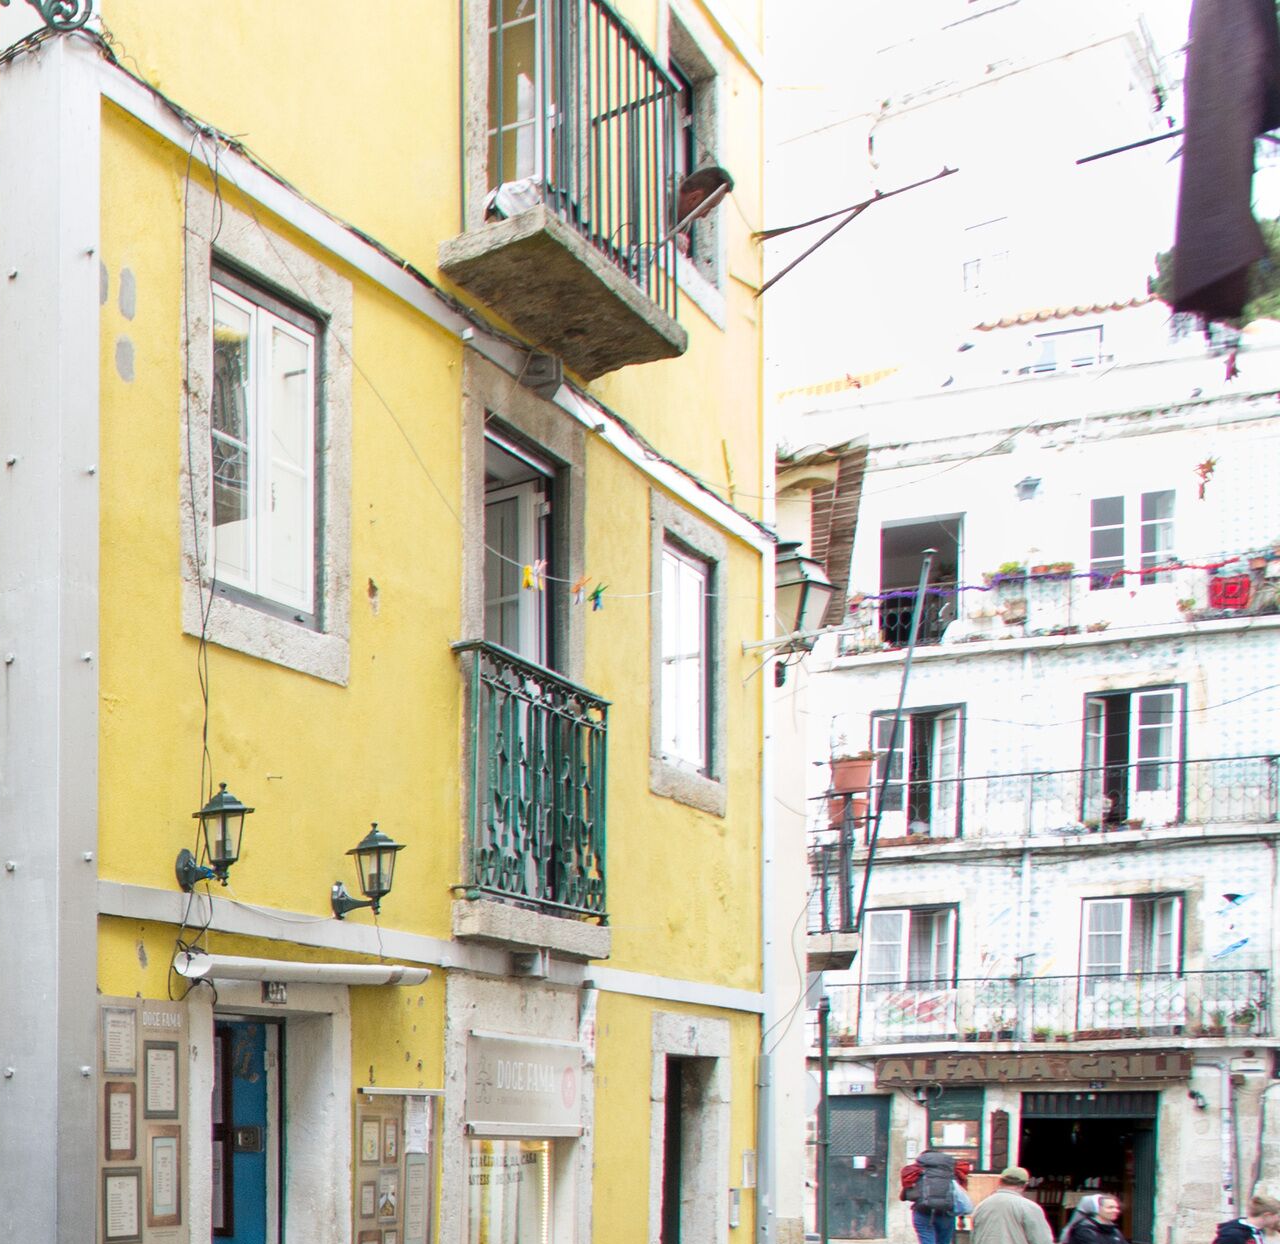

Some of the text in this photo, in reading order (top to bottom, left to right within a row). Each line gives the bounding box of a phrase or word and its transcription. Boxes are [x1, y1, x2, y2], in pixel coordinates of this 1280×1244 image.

[142, 1011, 160, 1026] DOCE
[496, 1060, 555, 1093] DOCE FAMA
[879, 1054, 1191, 1081] ALFAMA GRILL
